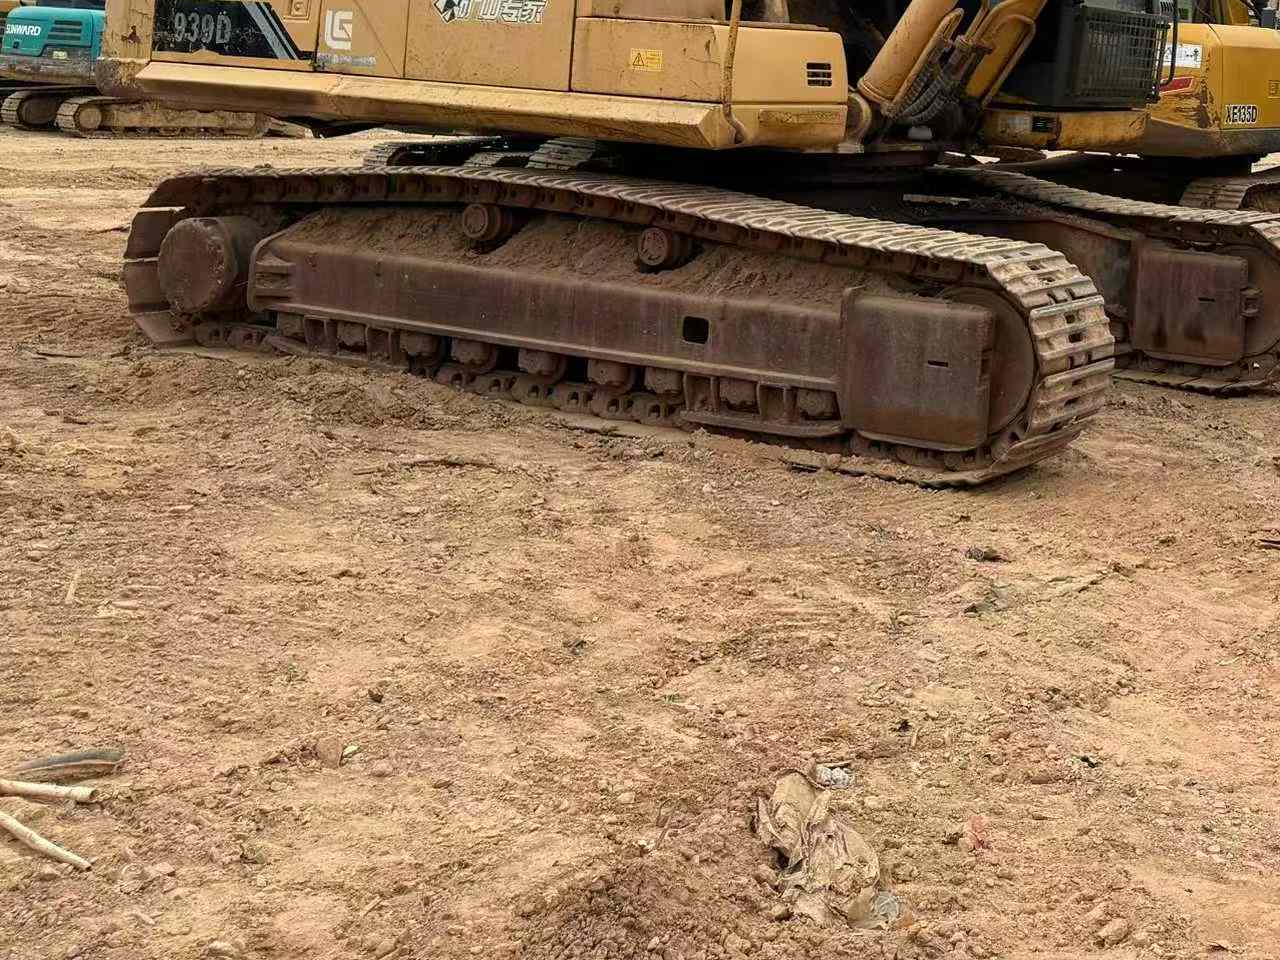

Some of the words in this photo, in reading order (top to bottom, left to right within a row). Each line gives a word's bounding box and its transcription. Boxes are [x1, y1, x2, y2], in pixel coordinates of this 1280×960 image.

[6, 24, 42, 36] SUNWARD
[174, 10, 232, 44] 939D
[1225, 105, 1258, 124] XE135D
